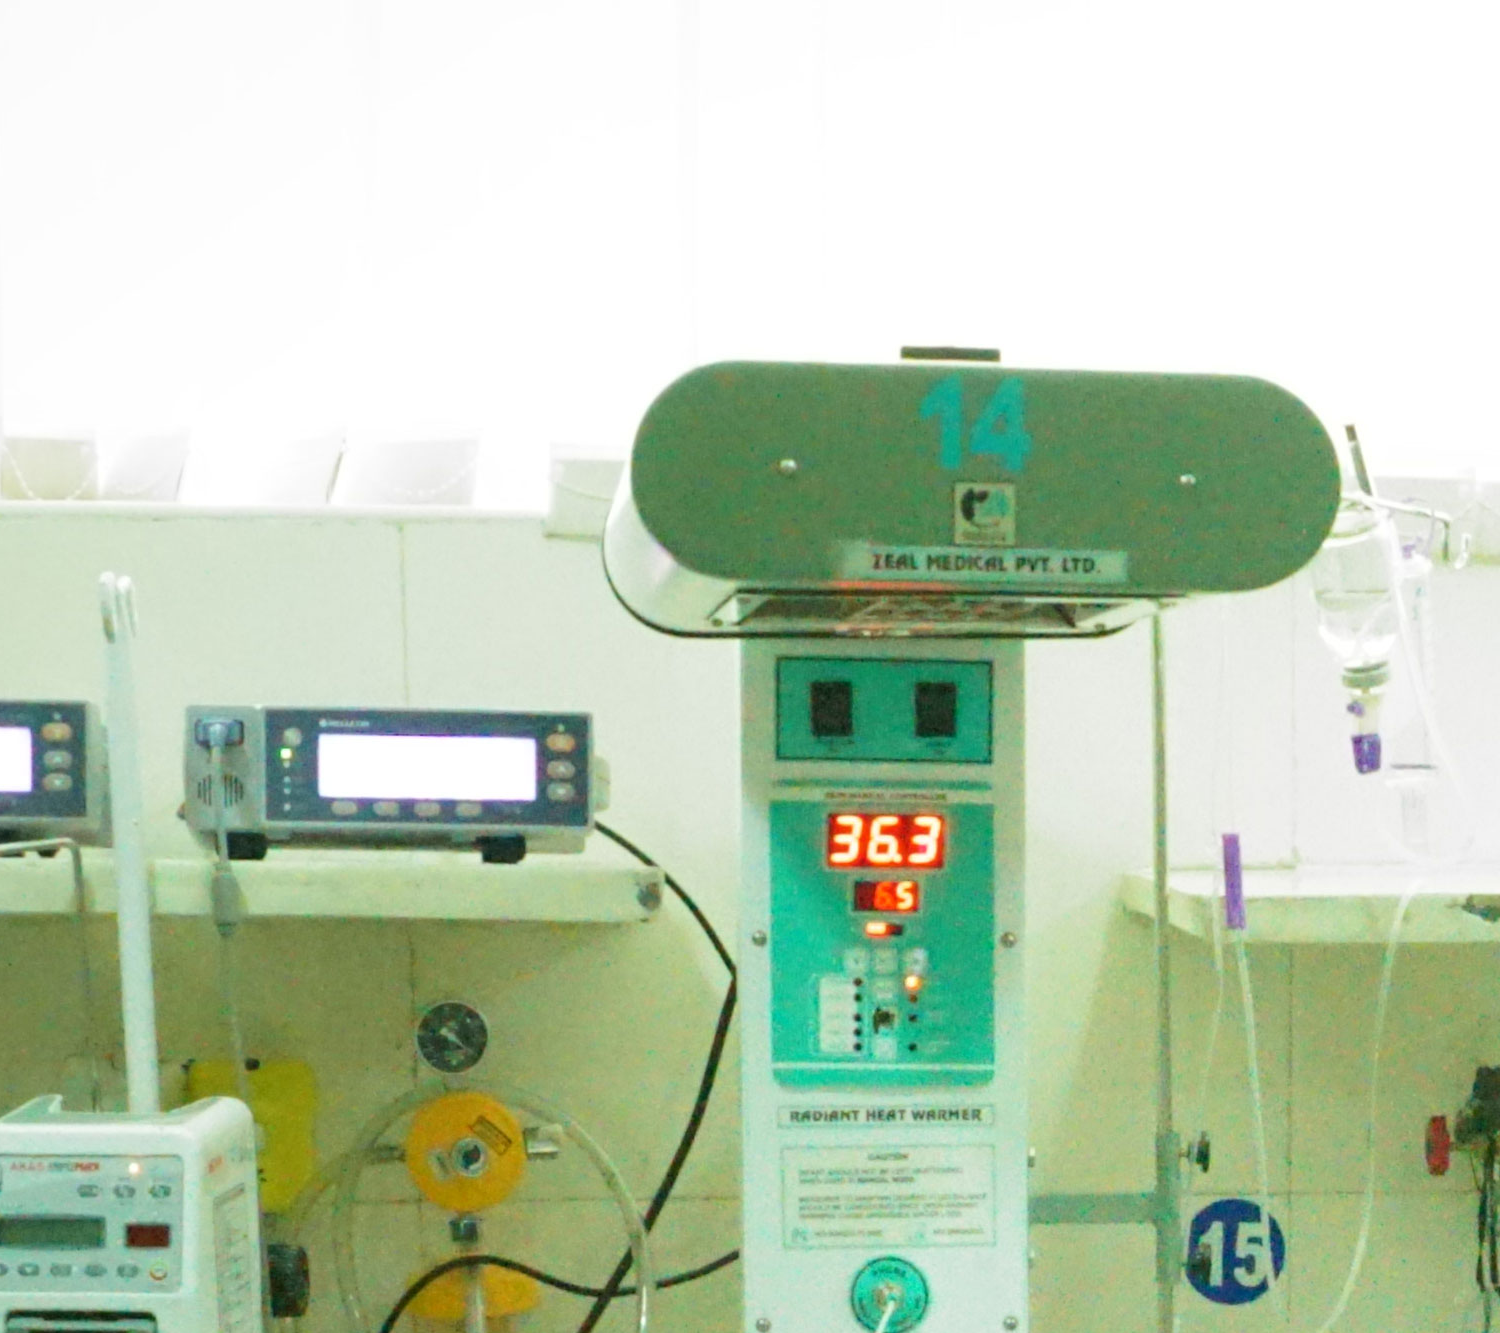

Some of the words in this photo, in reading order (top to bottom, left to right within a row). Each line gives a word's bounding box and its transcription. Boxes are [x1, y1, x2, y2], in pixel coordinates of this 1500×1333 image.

[919, 373, 1033, 470] 14
[872, 553, 918, 570] ZEAL
[927, 554, 1007, 571] MEDICAL
[789, 1109, 859, 1122] RADIANT
[866, 1109, 906, 1121] HEAT
[911, 1108, 983, 1121] WARMER
[1198, 1220, 1267, 1288] 15
